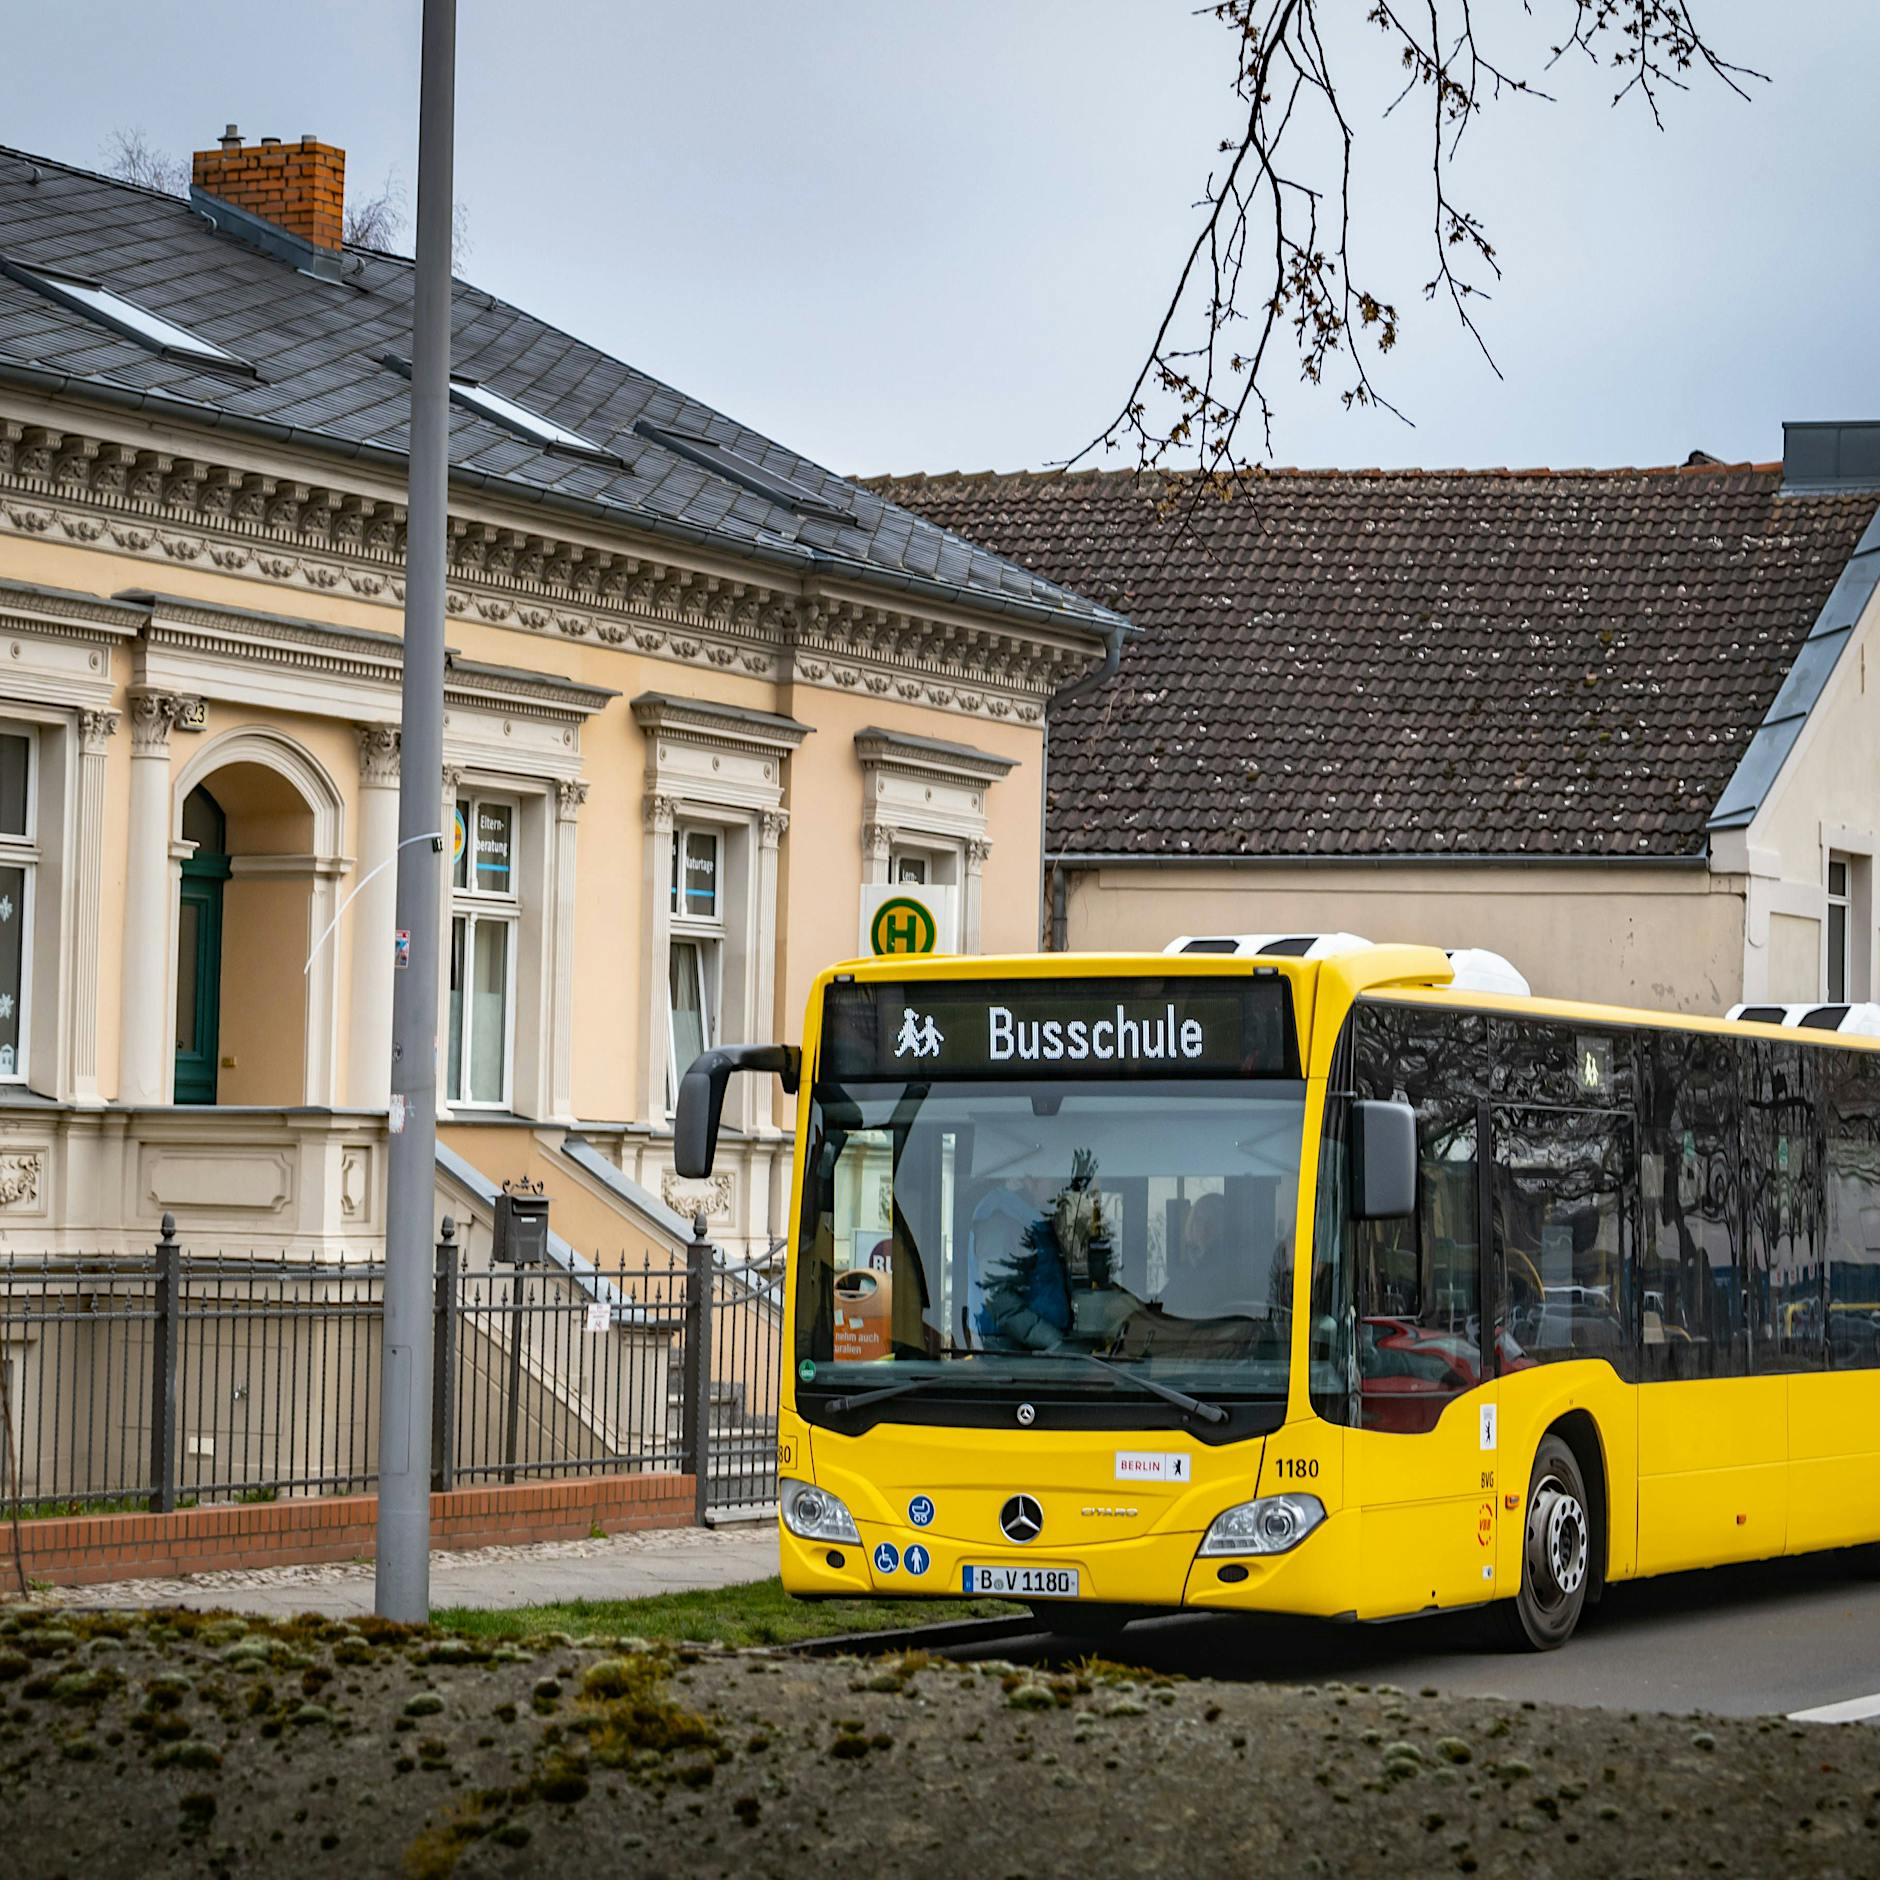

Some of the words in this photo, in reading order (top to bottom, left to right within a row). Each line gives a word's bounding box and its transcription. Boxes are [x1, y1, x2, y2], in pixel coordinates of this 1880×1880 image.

[480, 814, 505, 830] Eltern-
[886, 915, 917, 953] H
[988, 1004, 1203, 1060] Busschule
[858, 1332, 880, 1344] auch
[1120, 1460, 1161, 1472] BERLIN
[1275, 1458, 1320, 1478] 1180
[1481, 1471, 1494, 1488] BVG
[981, 1569, 993, 1590] B
[1006, 1570, 1018, 1591] V
[1022, 1571, 1070, 1593] 1180
